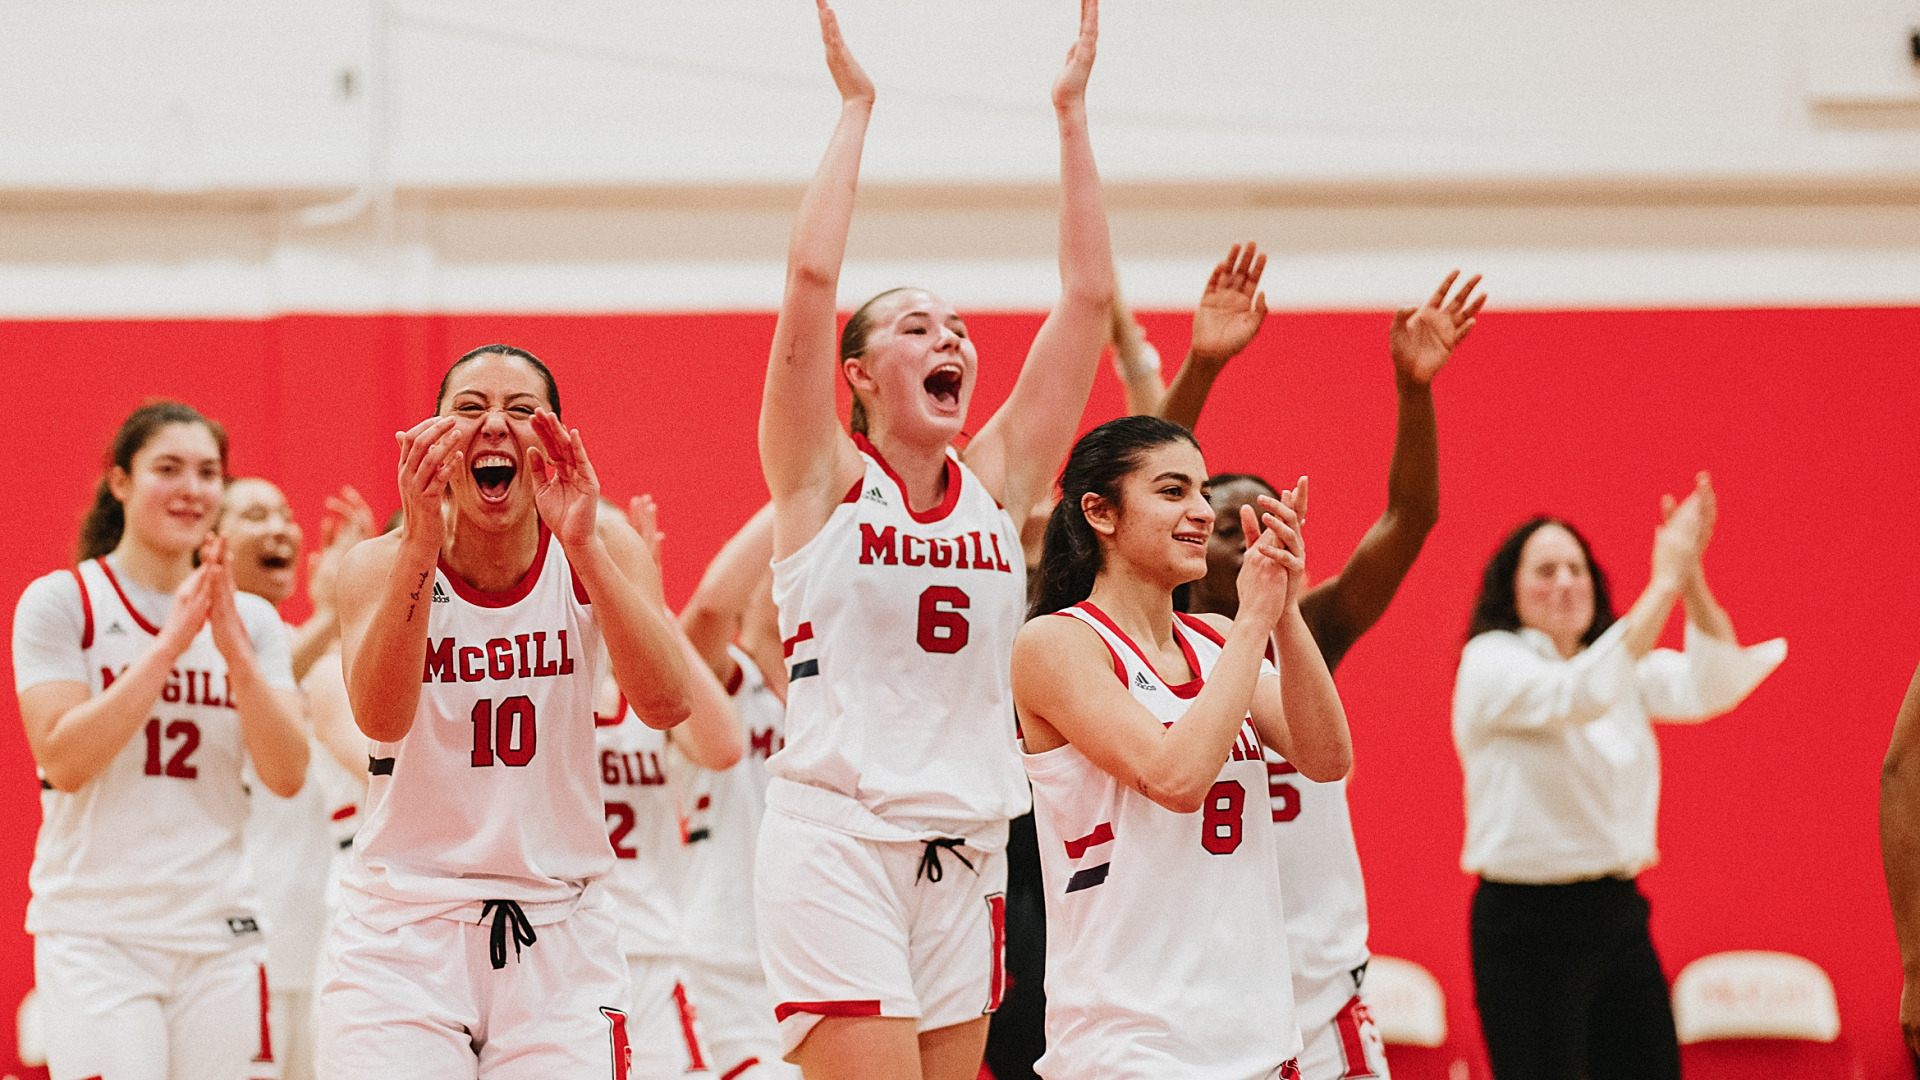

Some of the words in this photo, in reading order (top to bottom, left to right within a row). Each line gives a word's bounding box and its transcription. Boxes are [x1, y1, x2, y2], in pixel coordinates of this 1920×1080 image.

[917, 585, 970, 654] 6
[145, 718, 200, 779] 12
[471, 695, 536, 767] 10
[600, 749, 666, 785] GILL
[1201, 780, 1246, 855] 8
